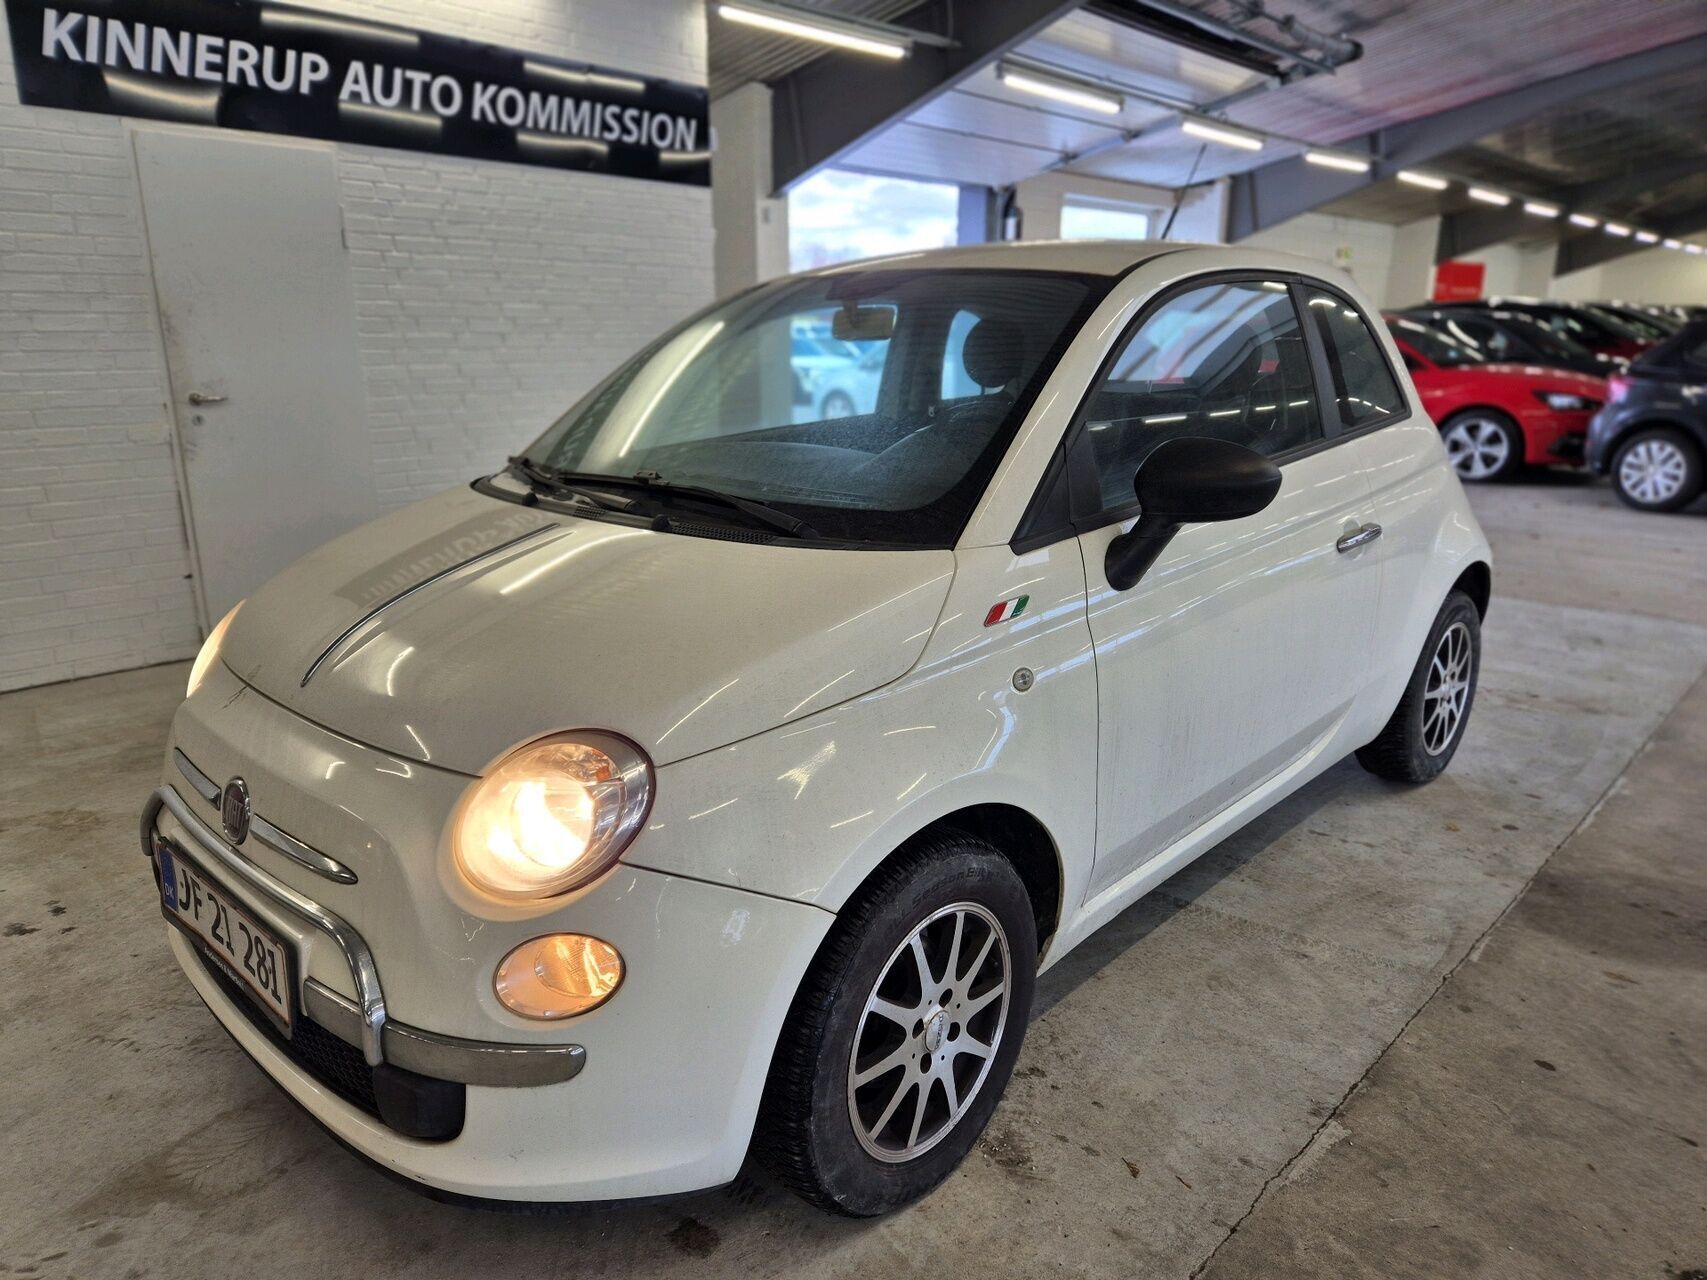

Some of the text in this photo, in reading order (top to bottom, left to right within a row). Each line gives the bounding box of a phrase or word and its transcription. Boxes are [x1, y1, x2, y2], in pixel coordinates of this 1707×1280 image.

[42, 8, 697, 151] KINNERUP AUTO KOMMISSION
[179, 868, 202, 921] JF
[207, 892, 235, 957] 21
[239, 921, 282, 1004] 281
